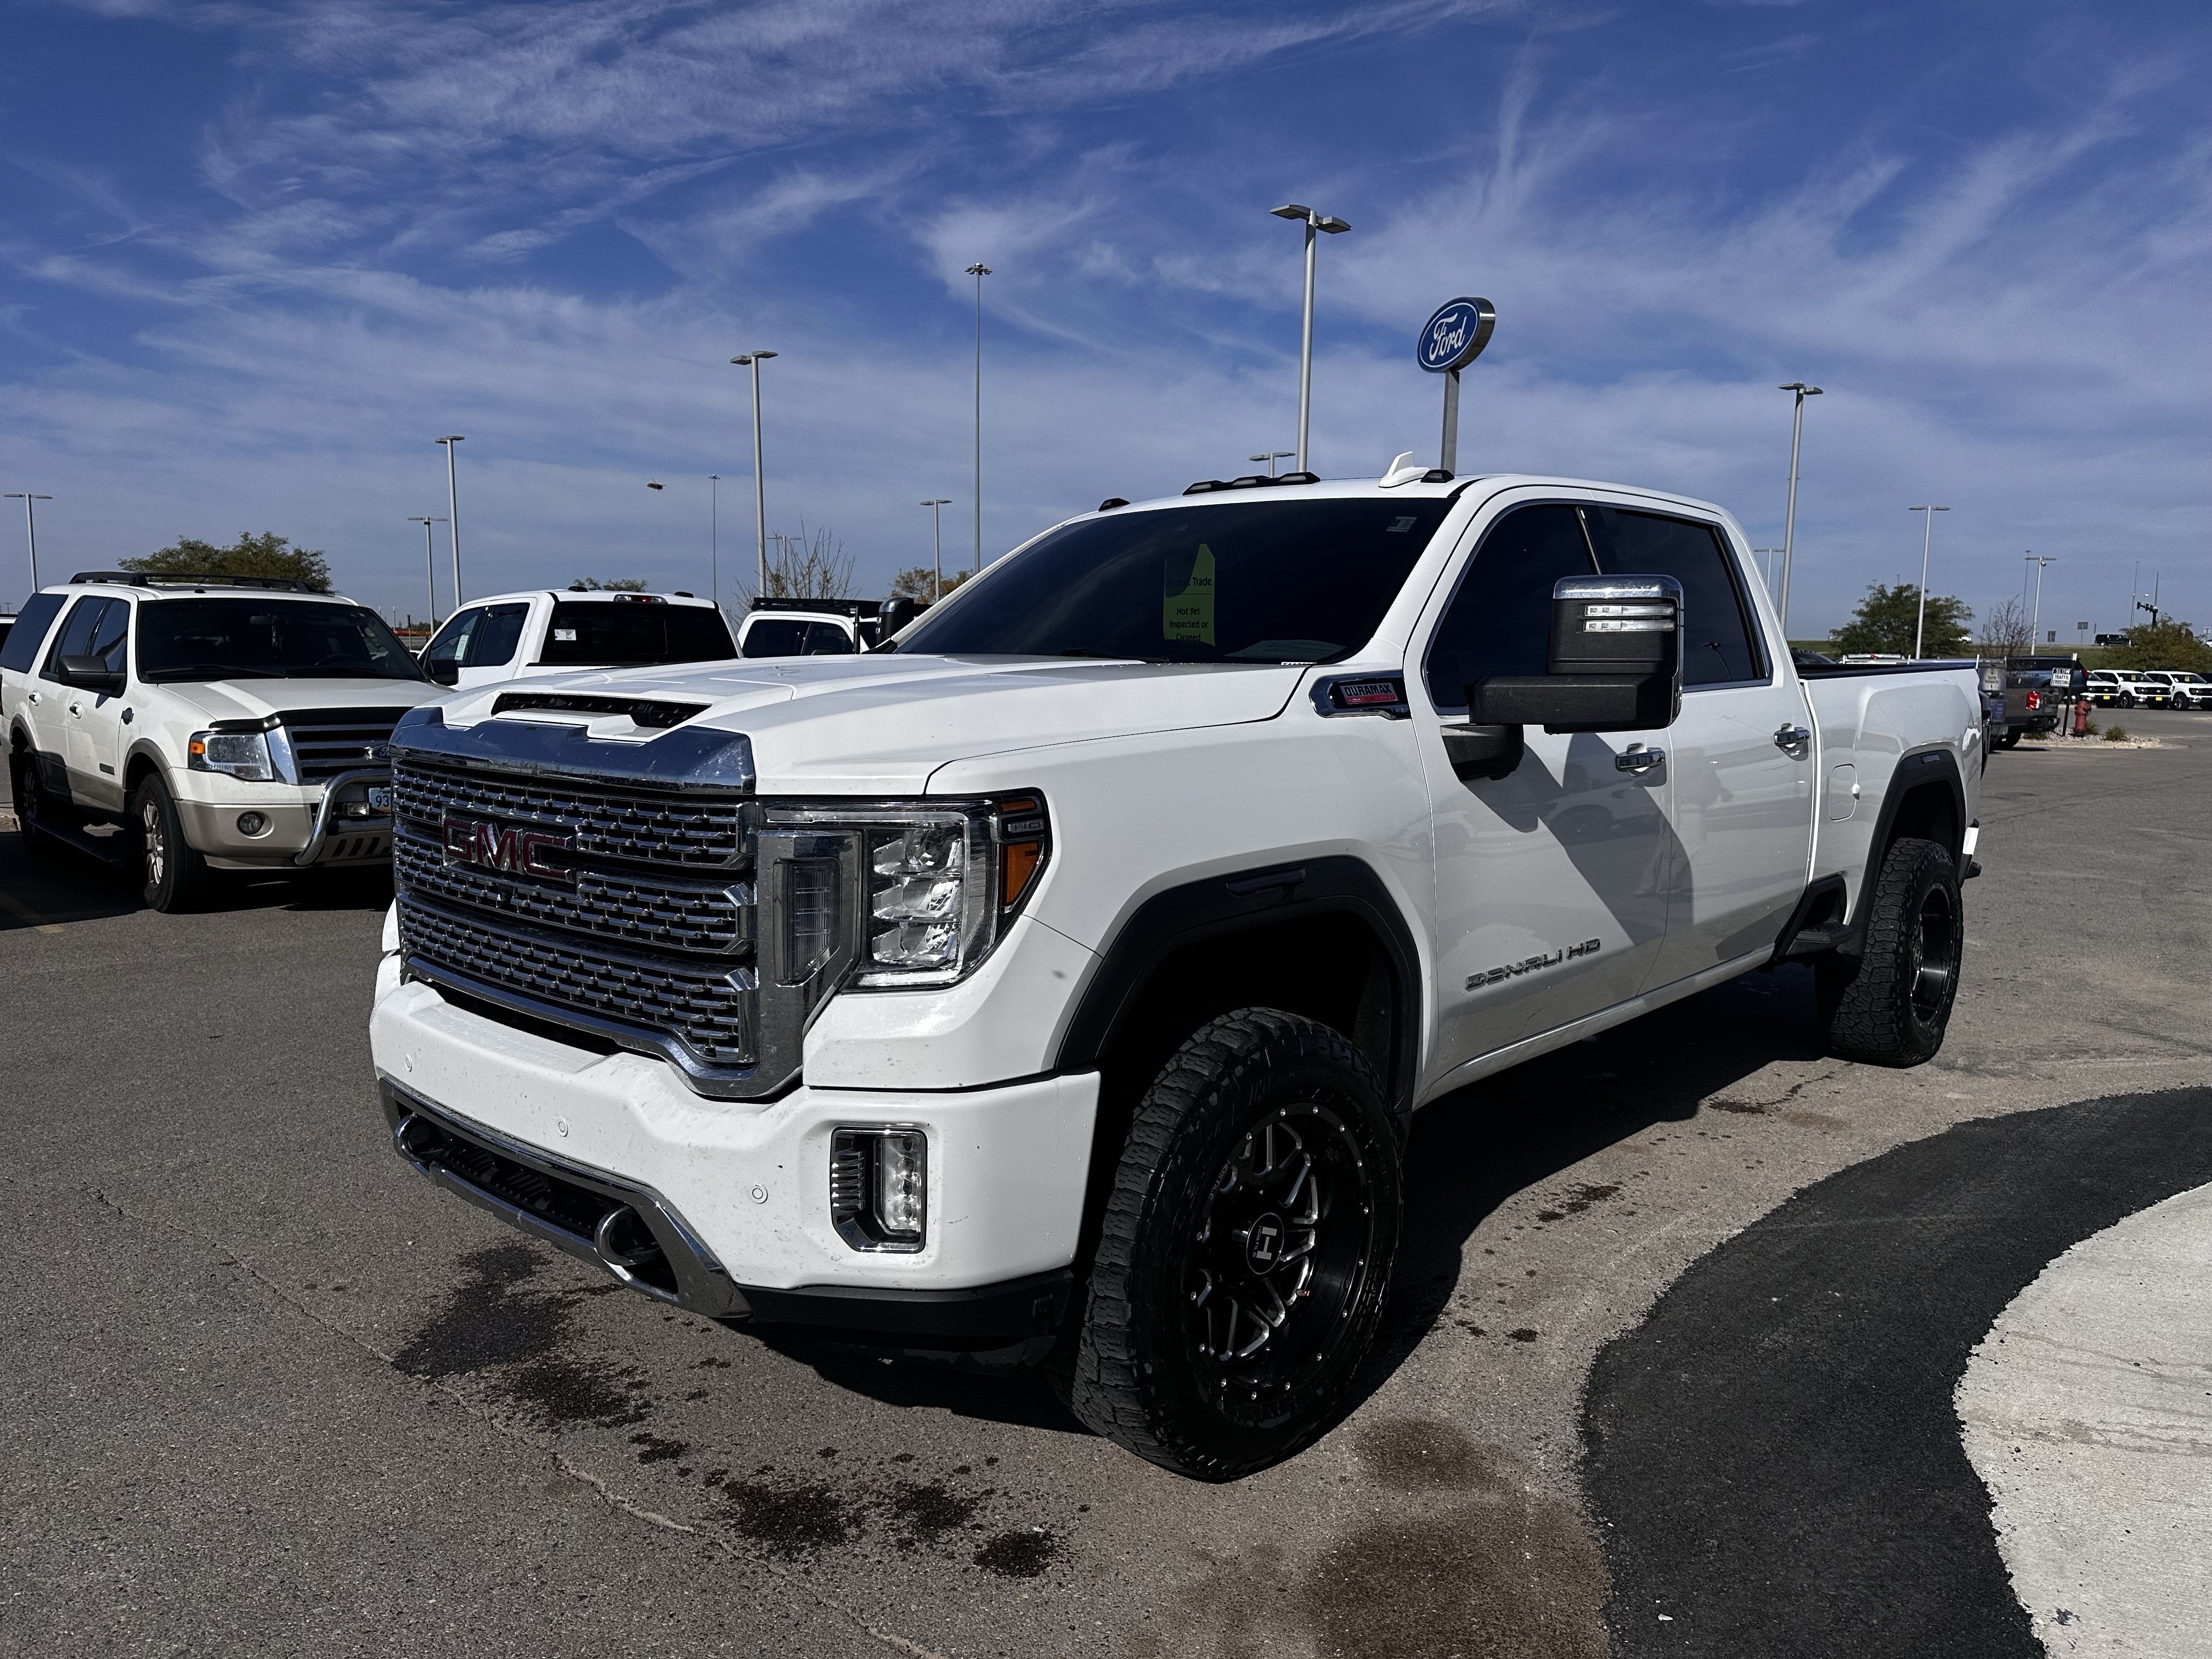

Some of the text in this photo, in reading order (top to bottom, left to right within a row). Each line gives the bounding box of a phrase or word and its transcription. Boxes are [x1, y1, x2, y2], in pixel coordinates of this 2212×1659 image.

[1429, 312, 1468, 362] Ford
[1167, 576, 1212, 587] Recent Trade
[1176, 607, 1200, 616] Not Yet
[1169, 620, 1200, 630] Inspected
[1176, 633, 1201, 642] Cleaned
[1344, 684, 1392, 697] DURAMAX
[443, 819, 572, 882] GMC
[1465, 938, 1601, 992] DENALI HD
[1208, 1159, 1231, 1201] HOSTILE
[1252, 1225, 1262, 1258] HOSTILE
